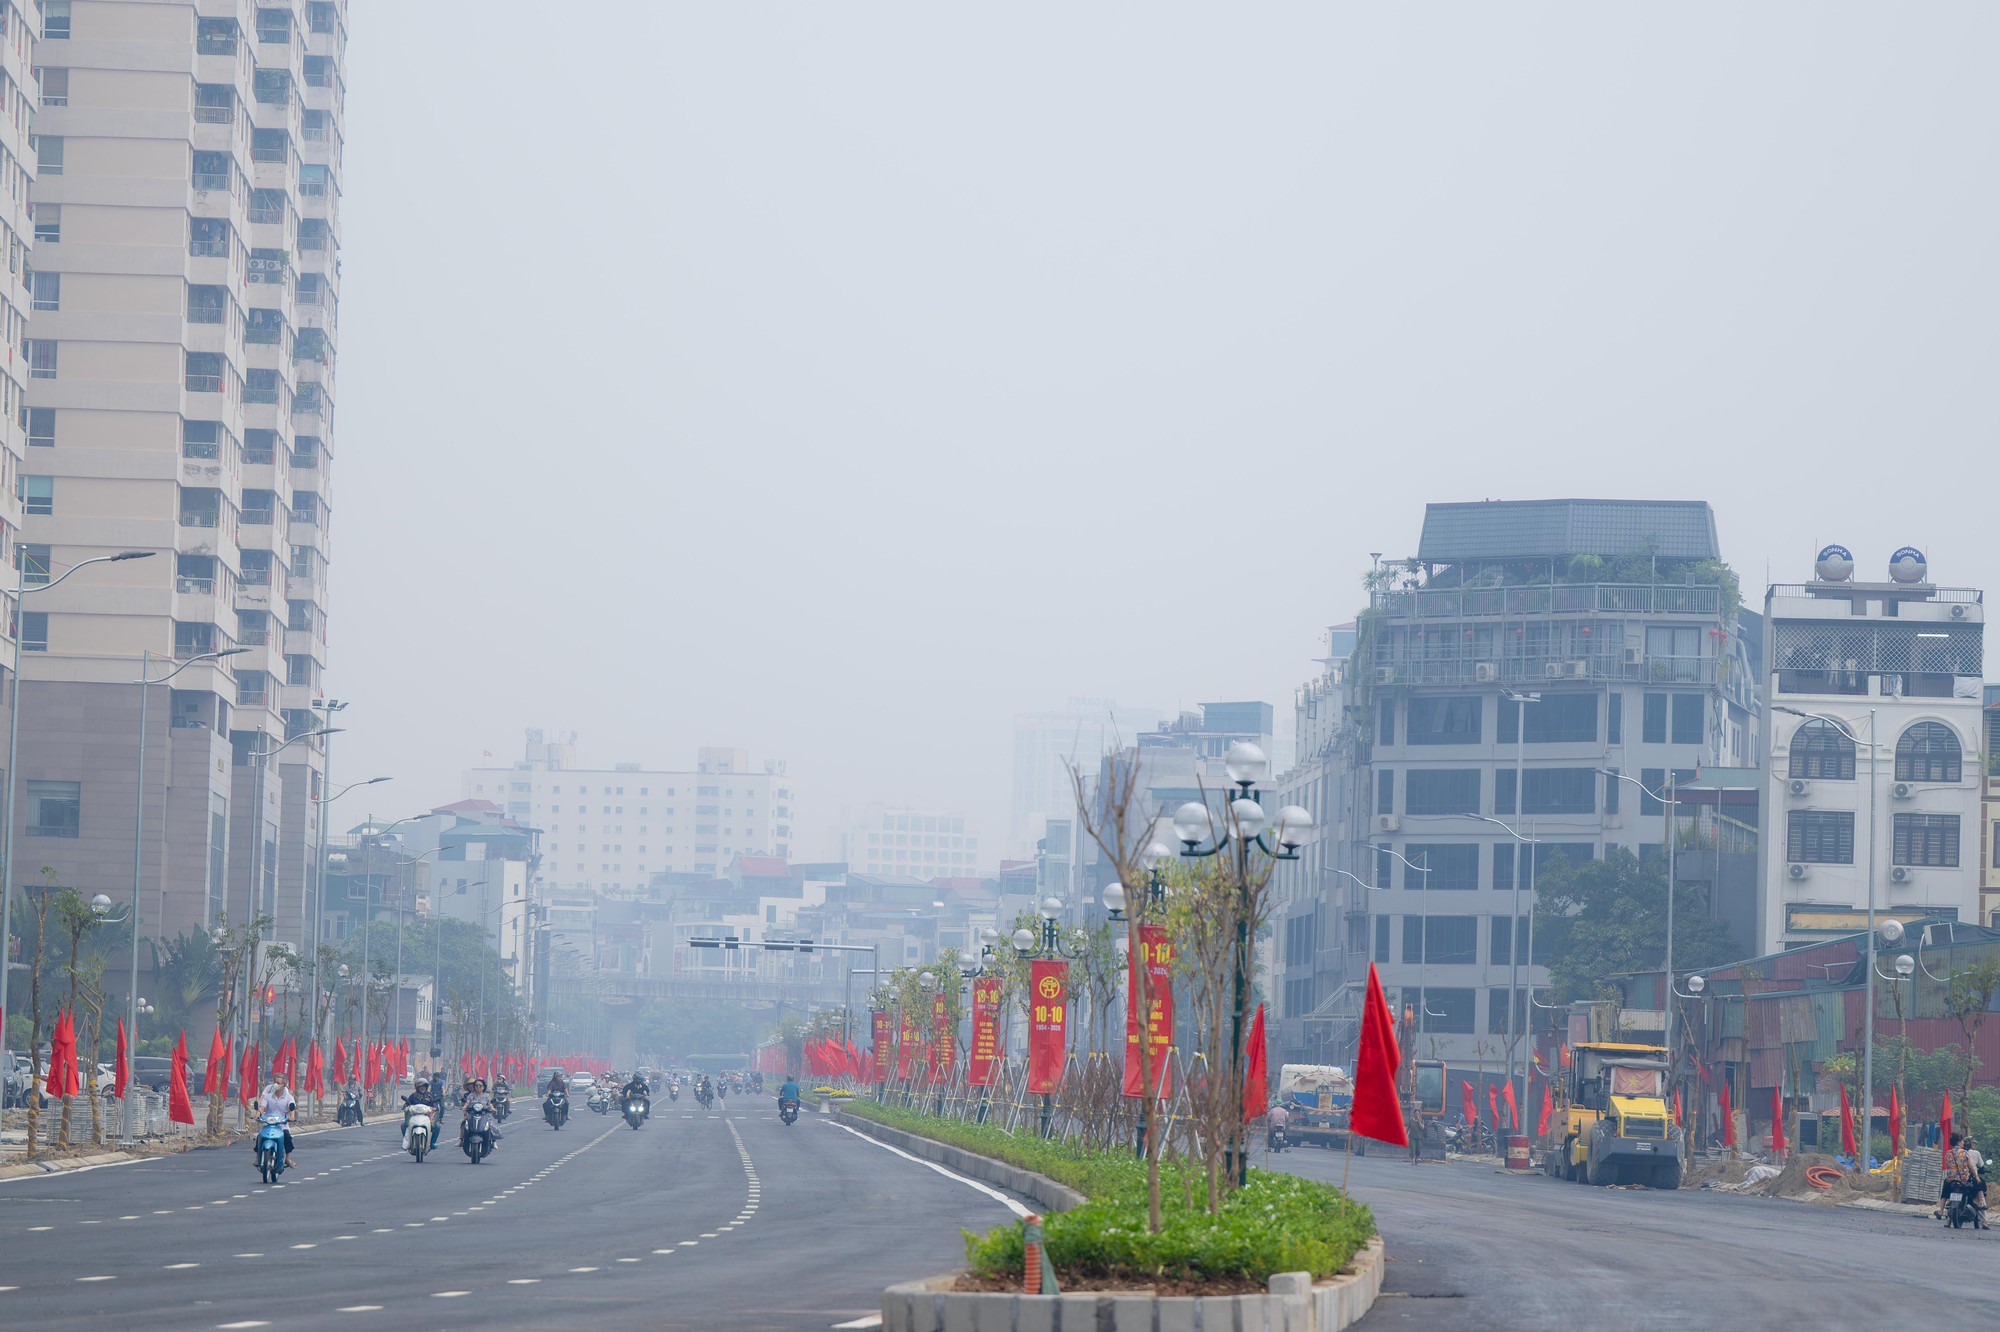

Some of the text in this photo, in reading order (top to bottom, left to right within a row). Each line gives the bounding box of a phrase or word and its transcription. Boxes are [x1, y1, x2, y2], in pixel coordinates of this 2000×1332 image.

[1823, 547, 1847, 557] SONHA
[1896, 549, 1920, 558] SONHA
[1141, 942, 1170, 964] 0-10
[1035, 1005, 1063, 1023] 10-10
